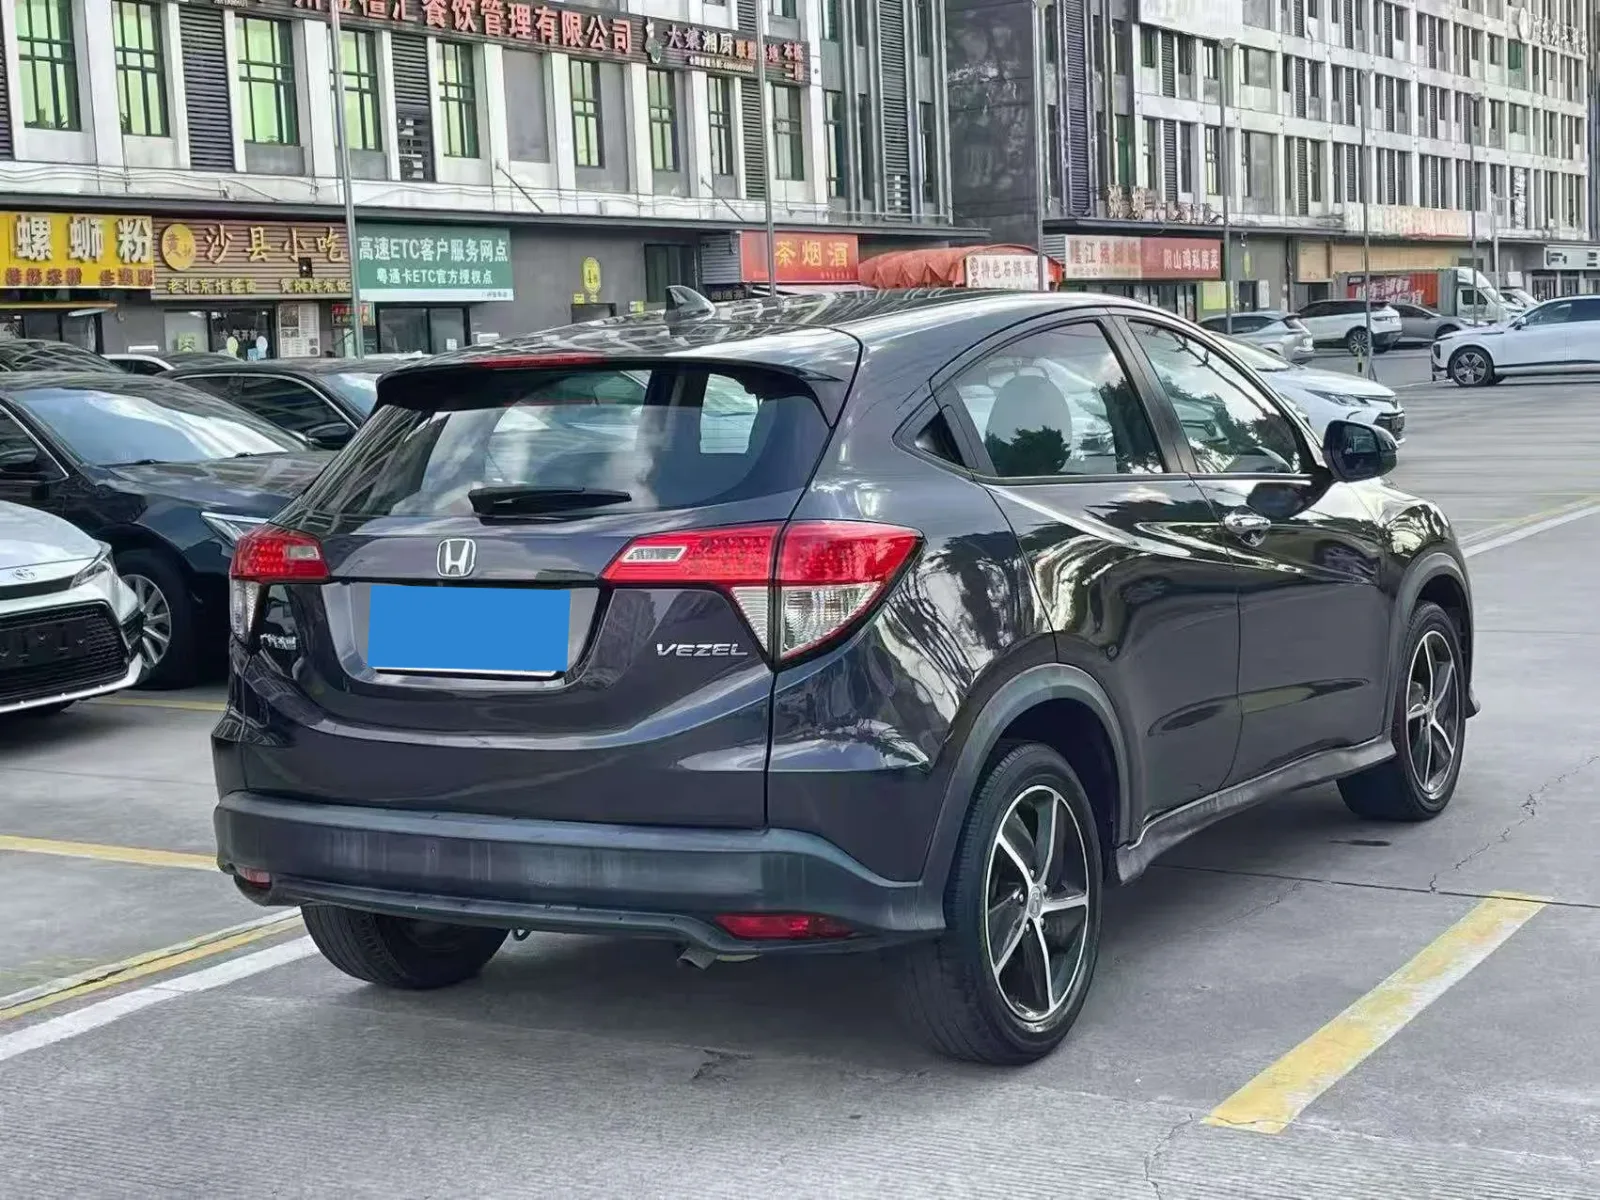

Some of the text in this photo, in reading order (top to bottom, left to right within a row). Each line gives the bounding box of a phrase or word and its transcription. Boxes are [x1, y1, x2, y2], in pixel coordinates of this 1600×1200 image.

[15, 214, 153, 264] 螺蛳粉
[204, 222, 346, 264] 沙县小吃
[358, 236, 509, 263] 高速ETC客户服务网点
[376, 267, 493, 285] 粤通卡ETC官方授权点
[656, 643, 748, 657] VEZEL
